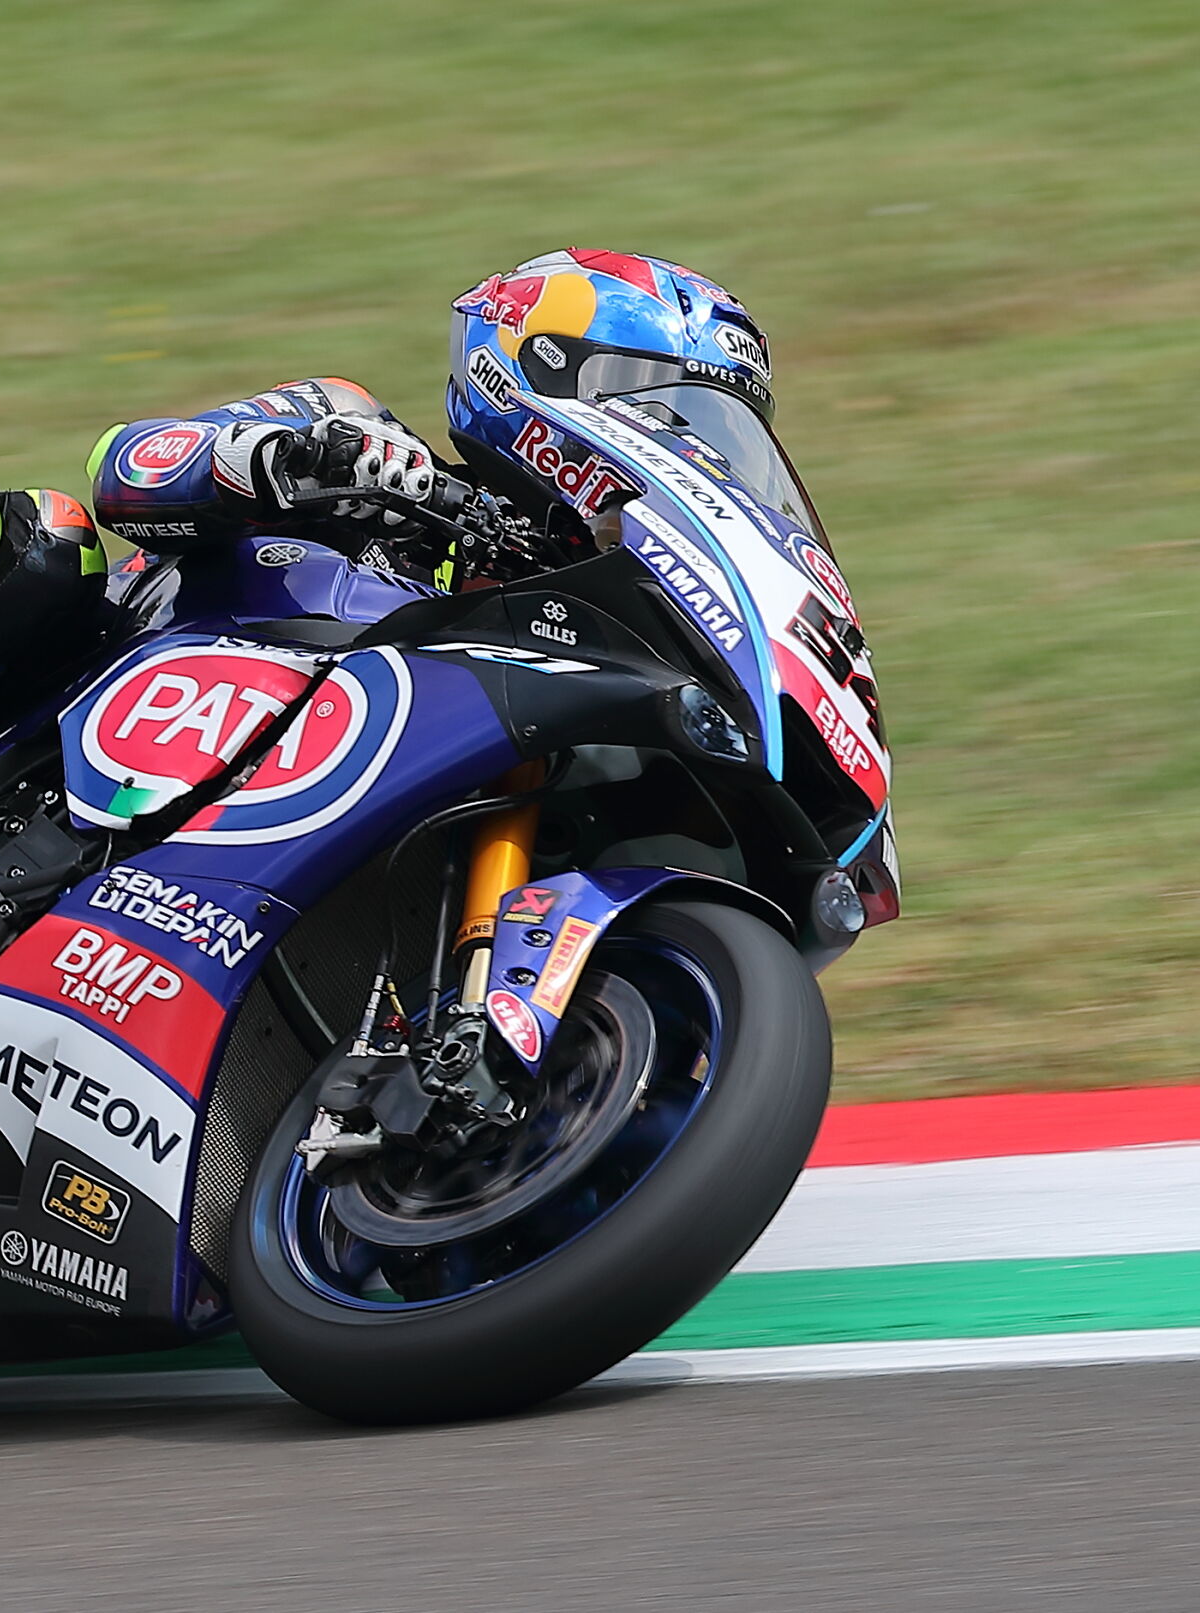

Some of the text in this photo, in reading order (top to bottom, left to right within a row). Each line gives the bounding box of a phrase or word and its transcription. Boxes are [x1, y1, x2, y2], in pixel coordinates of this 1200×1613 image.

[536, 340, 563, 365] SHOEI
[470, 353, 513, 407] SHOE
[685, 359, 737, 384] GIVES
[744, 377, 768, 402] YOU
[138, 436, 194, 460] PATA
[513, 418, 598, 498] Red
[111, 522, 198, 538] DAINESE
[637, 535, 745, 651] YAMAHA
[530, 620, 578, 646] GILLES
[114, 672, 314, 771] PATA
[814, 695, 872, 771] BMP
[124, 896, 246, 970] DEPAN
[52, 928, 184, 1007] BMP
[61, 973, 131, 1024] TAPPI
[492, 999, 531, 1049] HEL
[49, 1197, 111, 1235] Pro-Bolt
[62, 1174, 111, 1215] PB
[0, 1267, 34, 1288] YAMAHA
[34, 1280, 65, 1298] MOTOR
[86, 1297, 122, 1317] EUROPE
[31, 1237, 129, 1301] YAMAHA
